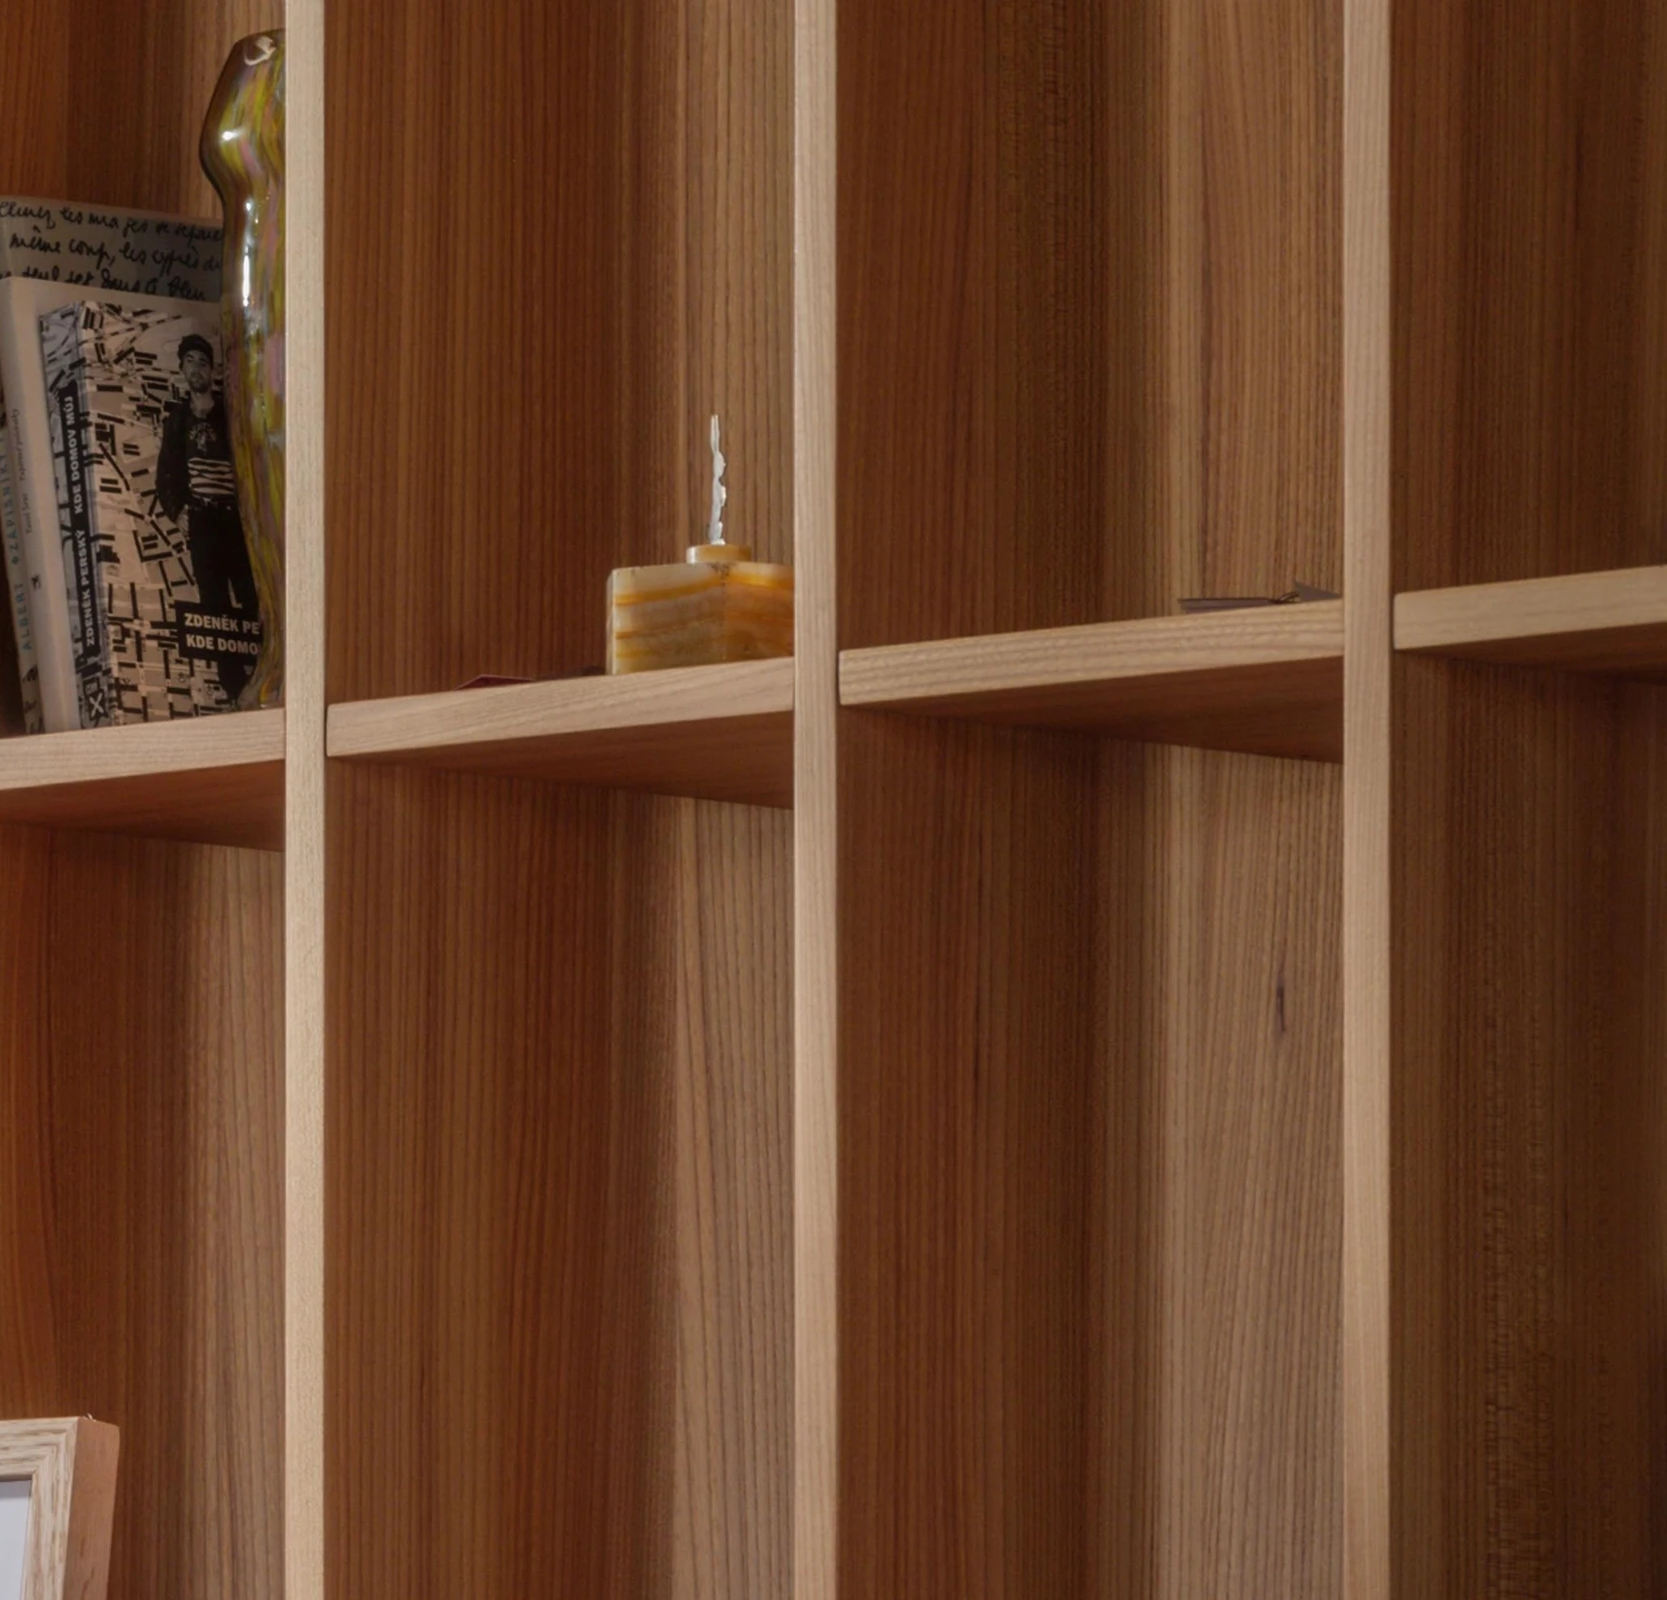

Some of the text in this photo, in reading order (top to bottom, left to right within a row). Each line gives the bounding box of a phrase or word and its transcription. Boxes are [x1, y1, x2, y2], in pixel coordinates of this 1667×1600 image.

[64, 395, 95, 647] ZDENĚK PERSKÝ KDE DOMOV MŮJ
[14, 583, 32, 650] ALBERT
[184, 612, 239, 633] ZDENĚK
[185, 634, 215, 651] KDE
